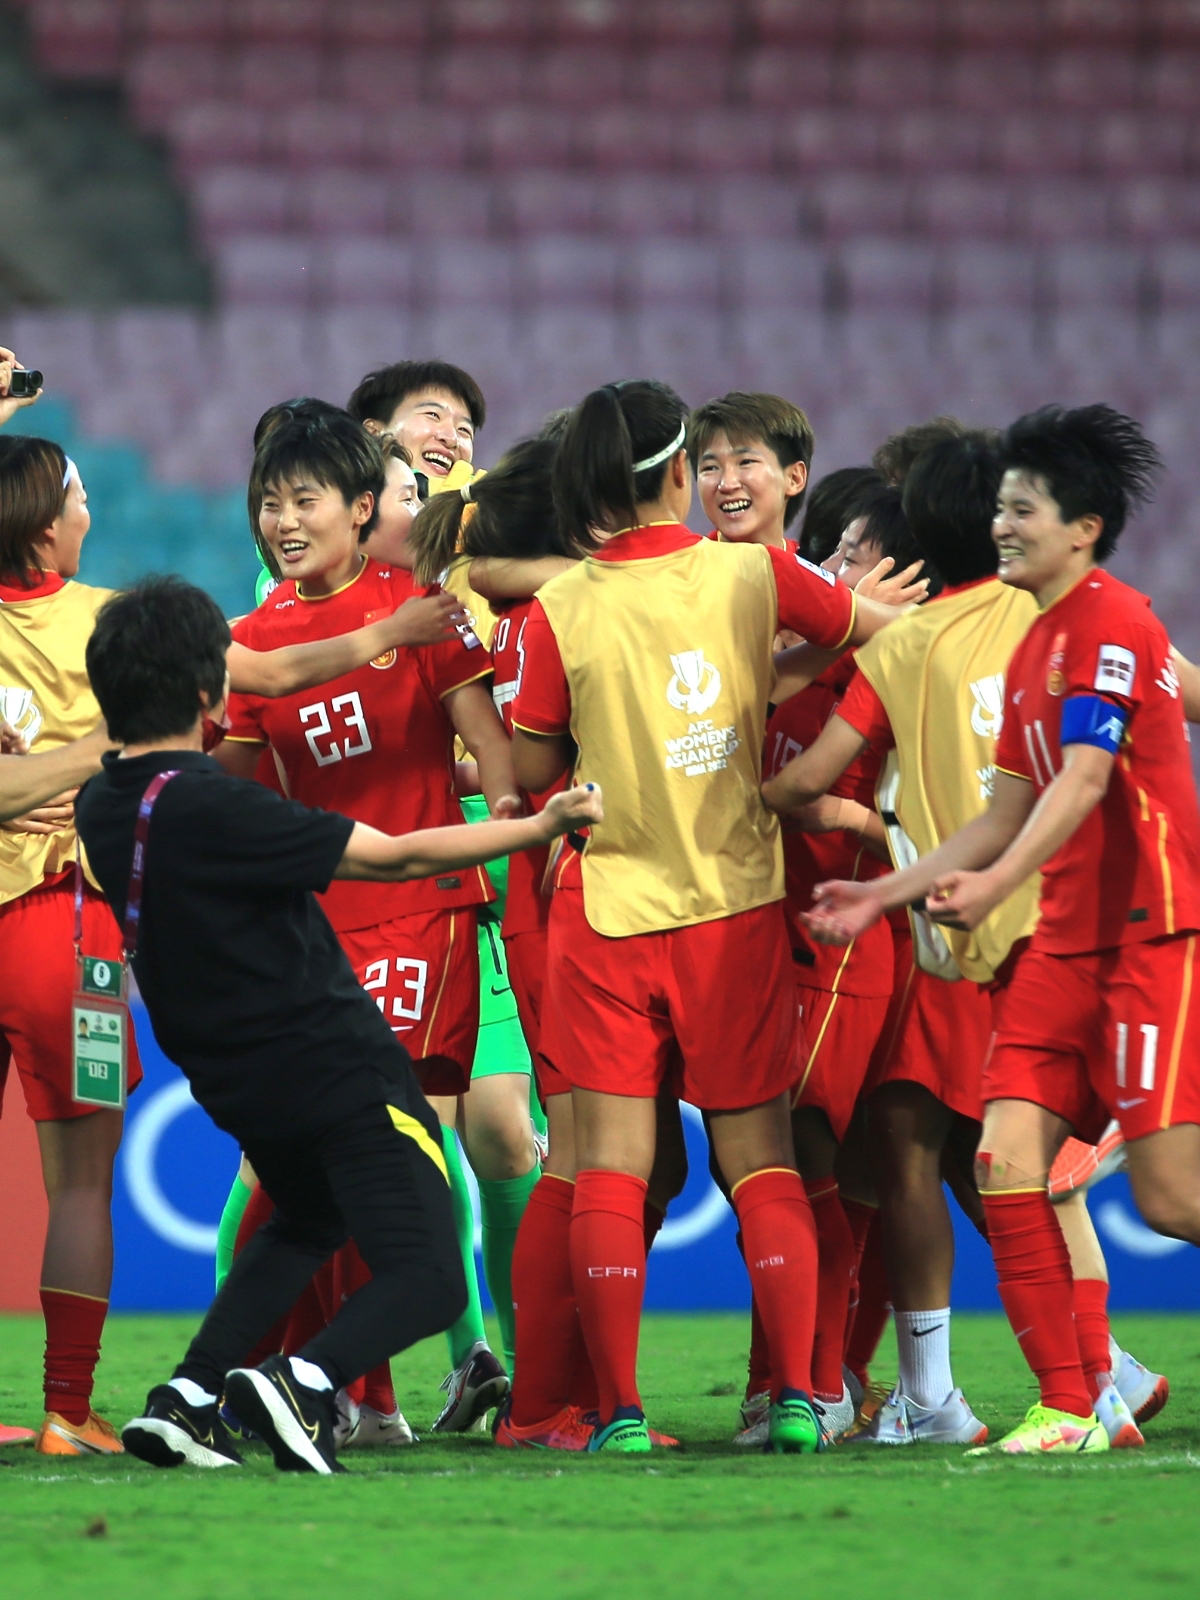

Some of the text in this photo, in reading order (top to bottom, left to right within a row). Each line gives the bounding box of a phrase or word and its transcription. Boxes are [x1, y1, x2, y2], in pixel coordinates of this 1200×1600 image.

[298, 690, 373, 767] 23
[664, 725, 737, 755] WOMEN'S
[687, 718, 715, 735] AFC
[664, 739, 739, 771] ASIAN CUP
[362, 956, 429, 1021] 23
[1116, 1021, 1160, 1091] 11
[587, 1266, 638, 1279] CFA
